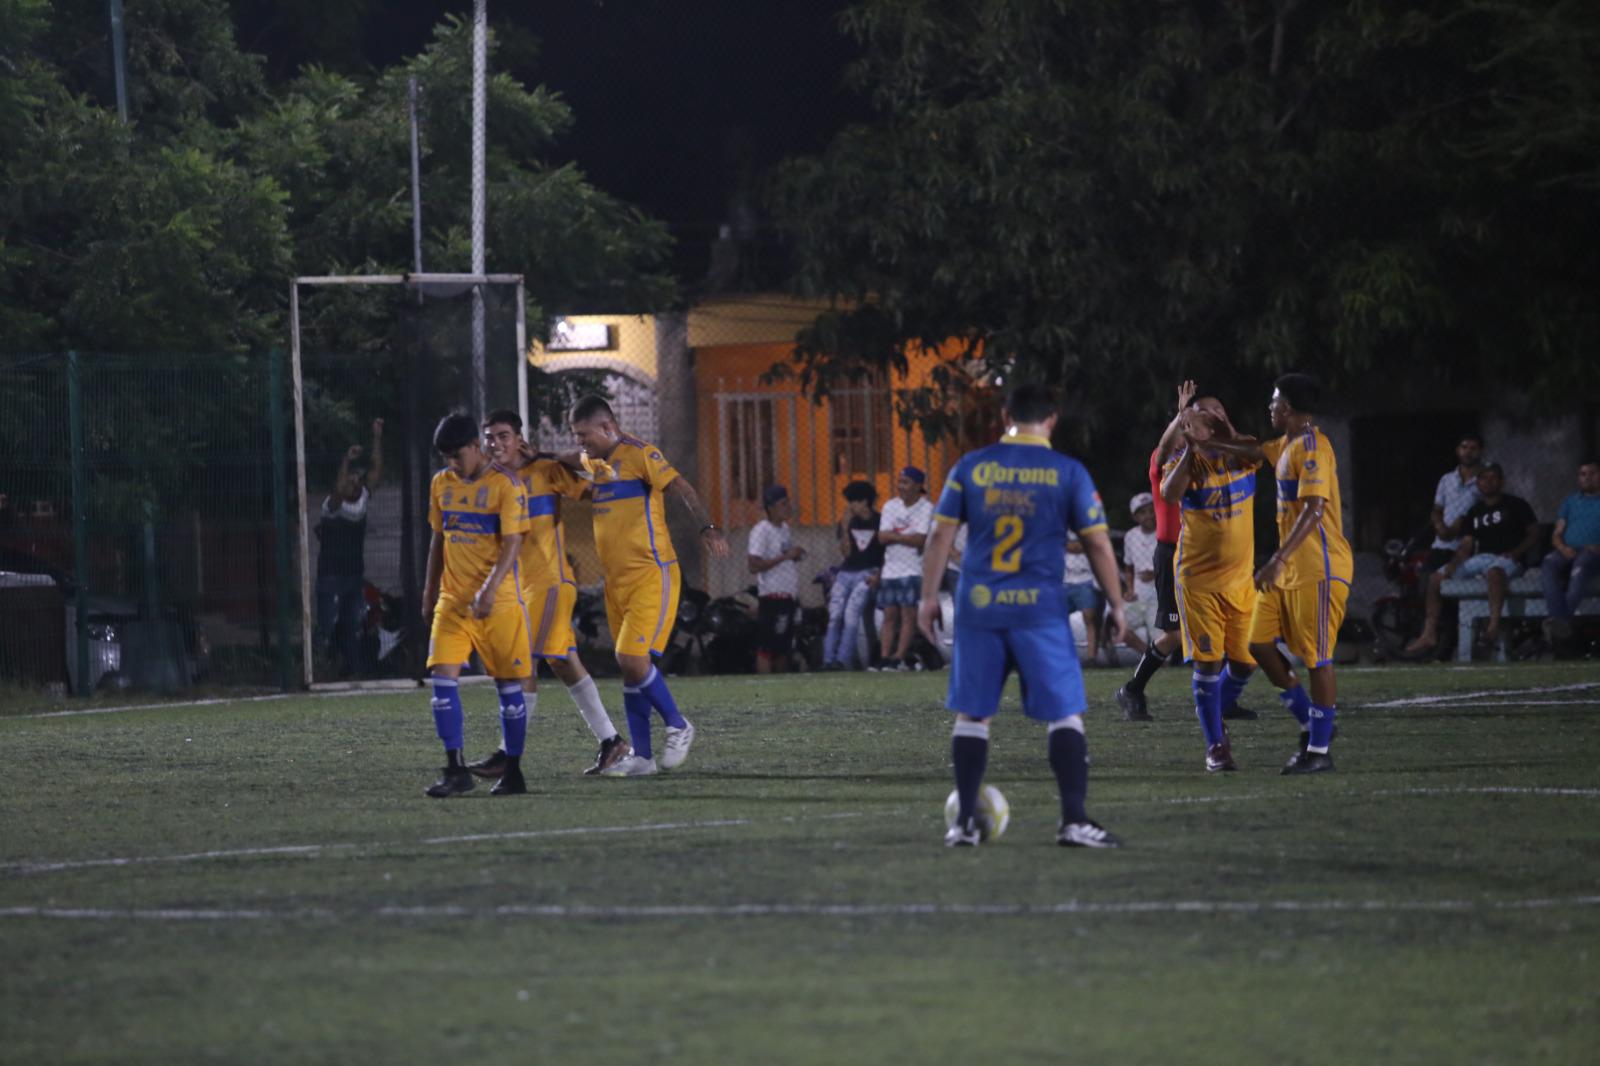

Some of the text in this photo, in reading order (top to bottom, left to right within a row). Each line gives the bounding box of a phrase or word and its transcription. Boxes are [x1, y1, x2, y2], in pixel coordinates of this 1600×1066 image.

[972, 461, 1059, 487] Corona
[991, 514, 1025, 574] 2
[995, 589, 1040, 605] AT&T
